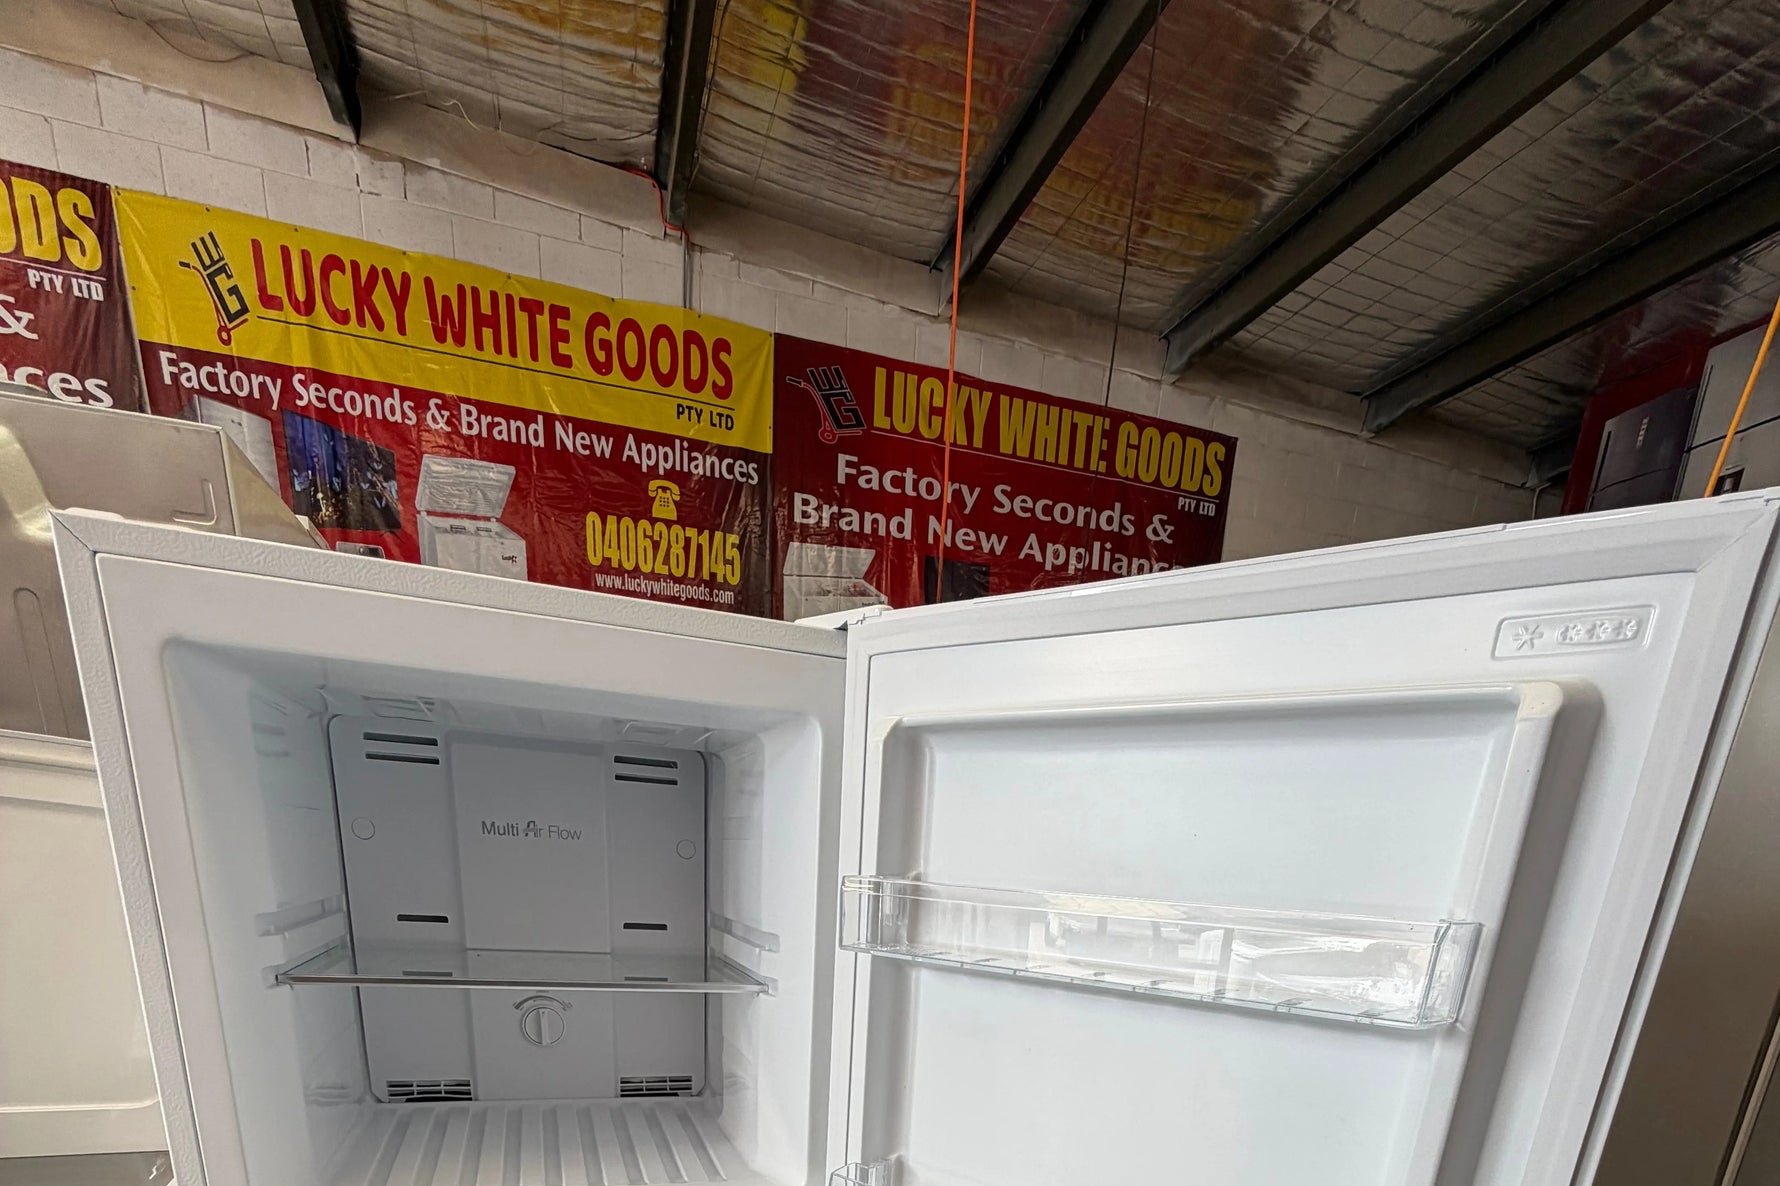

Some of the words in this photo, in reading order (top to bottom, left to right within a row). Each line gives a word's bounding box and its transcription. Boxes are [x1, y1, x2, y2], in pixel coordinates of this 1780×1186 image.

[27, 269, 64, 295] PTY
[71, 277, 104, 301] LTD
[250, 238, 411, 336] LUCKY
[423, 276, 573, 369] WHITE
[584, 311, 733, 400] GOODS
[0, 362, 114, 408] ces
[159, 351, 282, 411] Factory
[292, 373, 417, 426] Seconds
[426, 398, 451, 431] &
[459, 403, 545, 448] Brand
[554, 422, 614, 458] New
[622, 433, 759, 485] Appliances
[676, 403, 704, 424] PTY
[709, 409, 735, 431] LTD
[873, 366, 993, 448] LUCKY
[999, 394, 1111, 473] WHITE
[1115, 421, 1226, 497] GOODS
[836, 453, 981, 514] Factory
[993, 484, 1135, 536] Seconds
[1145, 514, 1175, 544] &
[1177, 497, 1196, 512] PTY
[1199, 503, 1216, 516] LTD
[586, 511, 741, 586] 0406287145
[793, 492, 913, 540] Brand
[927, 515, 1008, 555] New
[1018, 533, 1185, 575] Applian
[595, 572, 735, 604] www.luckywhitegoods.com
[481, 820, 519, 837] Multi
[548, 825, 582, 840] Flow
